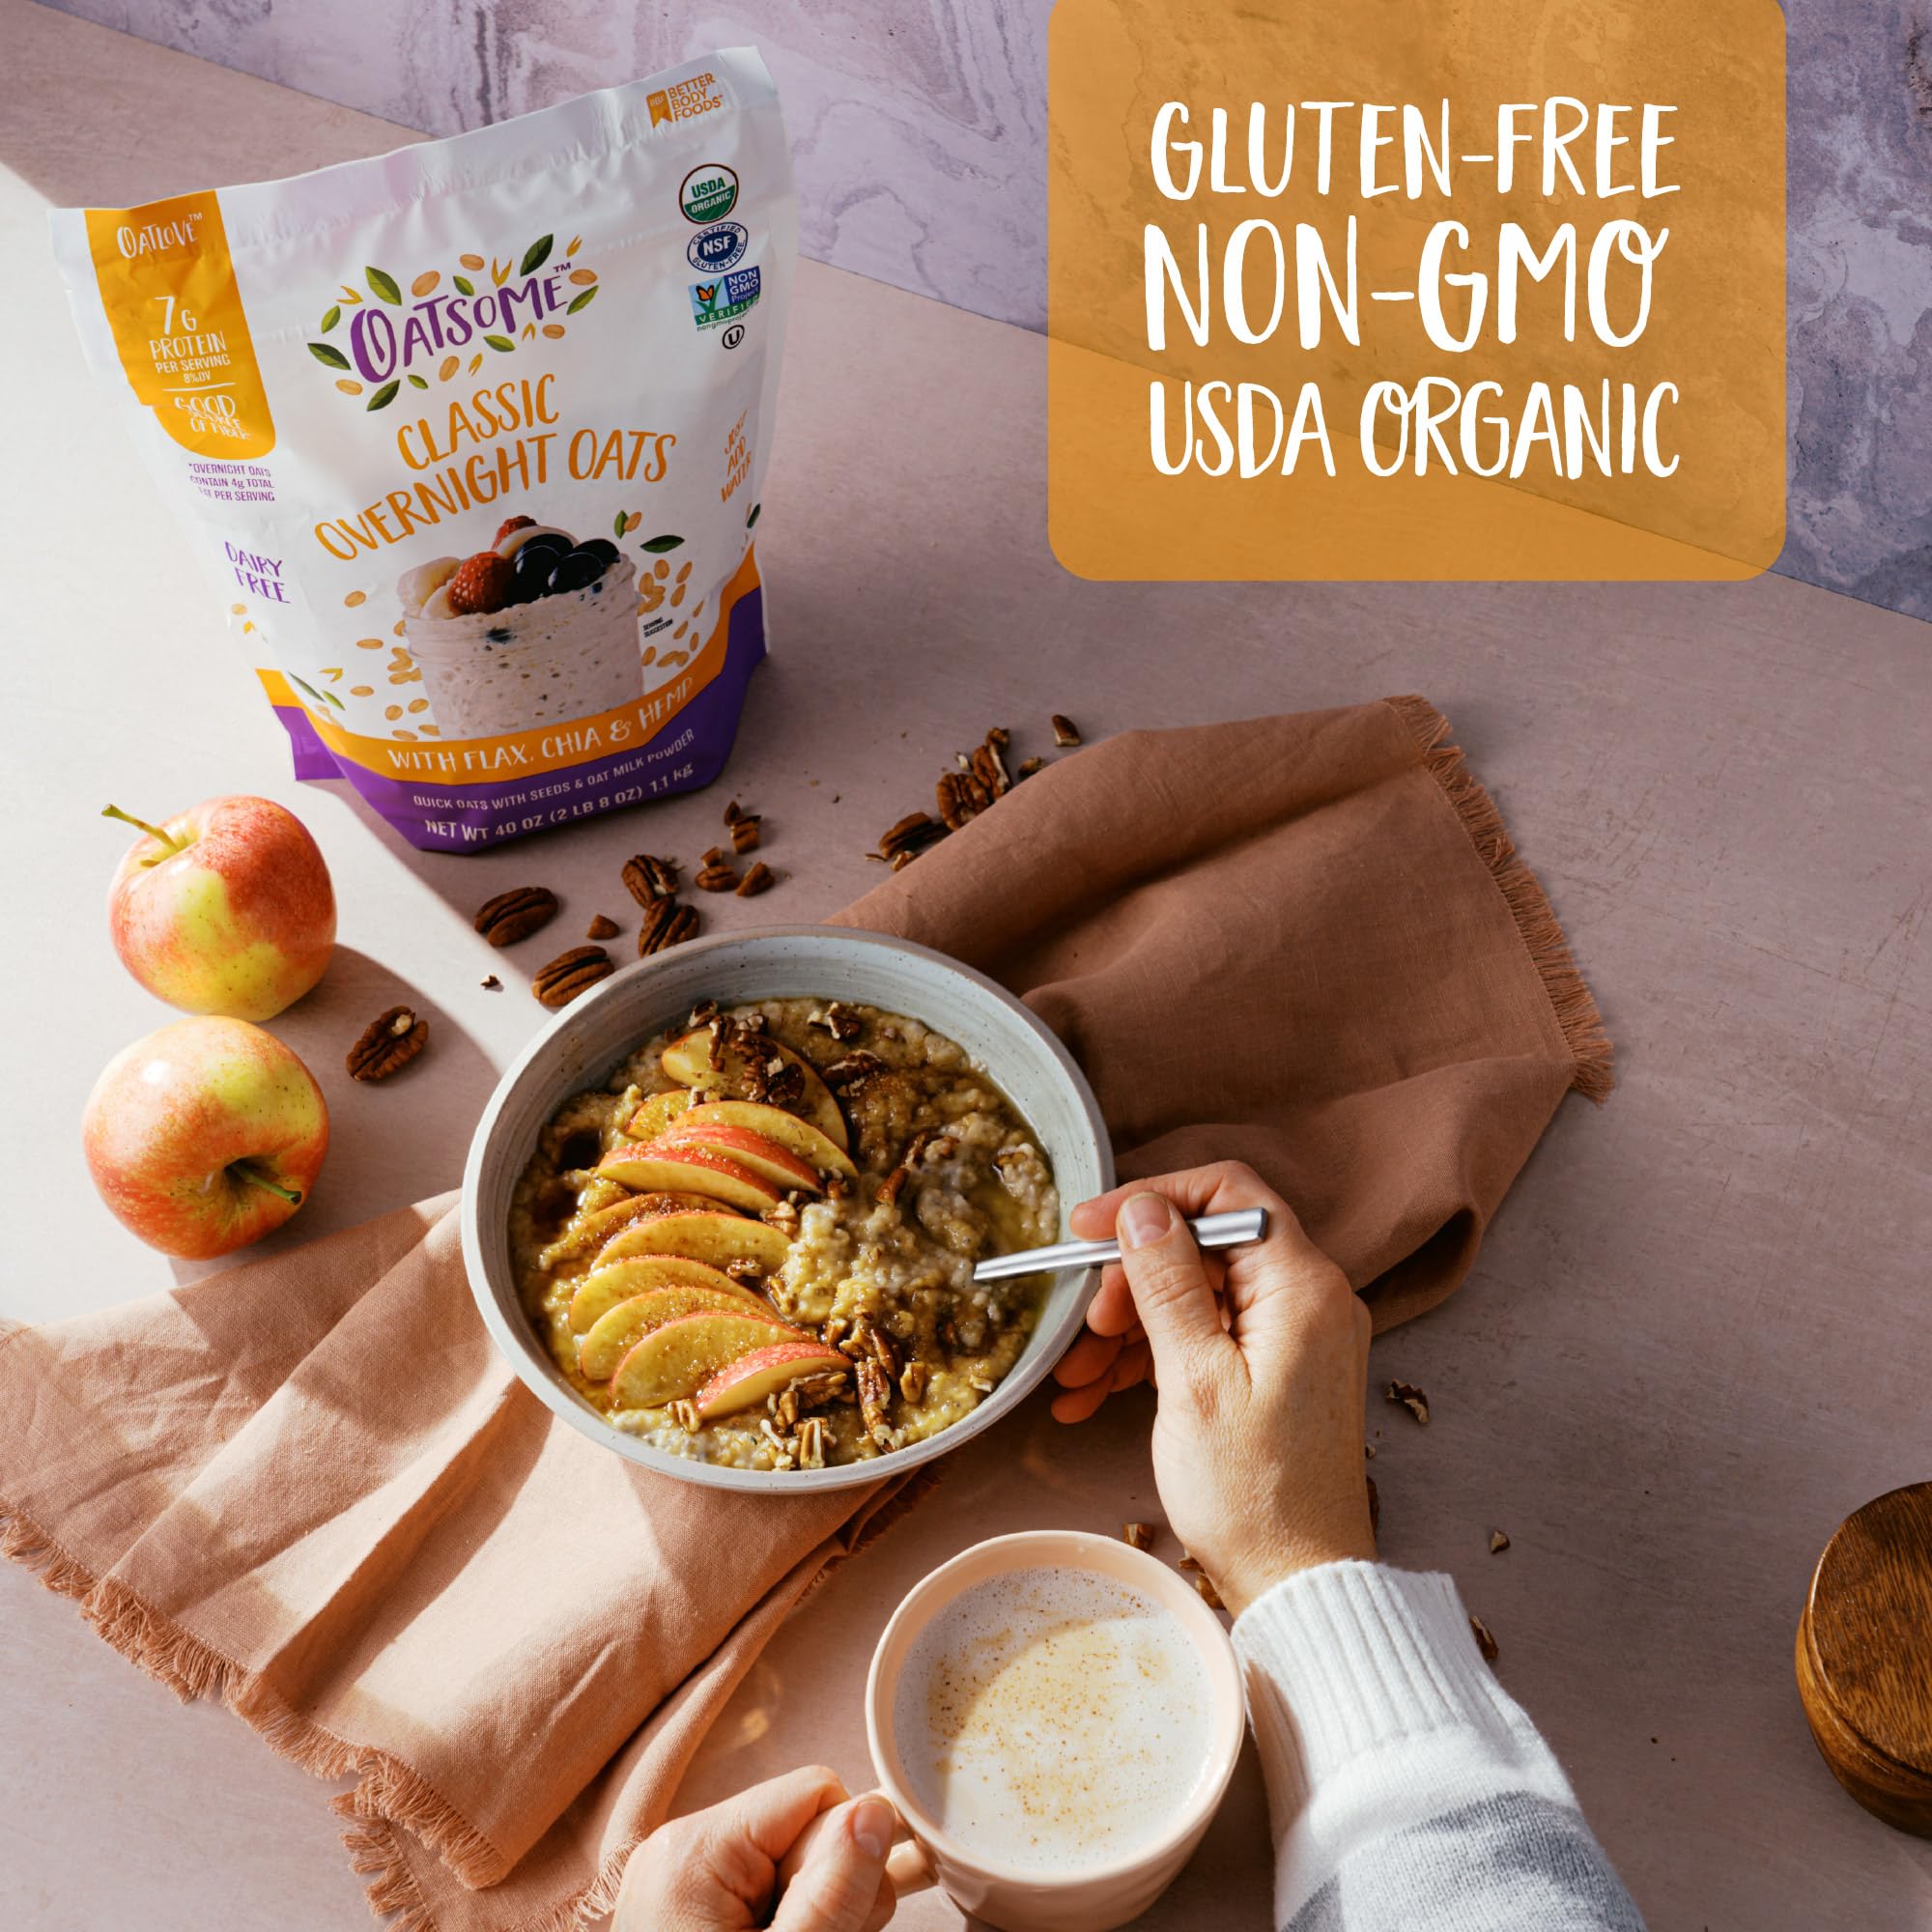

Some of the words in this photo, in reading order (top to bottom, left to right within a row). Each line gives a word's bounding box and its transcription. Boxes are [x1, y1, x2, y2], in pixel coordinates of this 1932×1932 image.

[668, 72, 716, 99] BETTER
[671, 88, 706, 110] BODY
[691, 177, 725, 199] USDA
[691, 191, 731, 213] ORGANIC
[693, 224, 742, 245] CERTIFIED
[702, 235, 732, 257] NSF
[727, 270, 757, 286] NON
[729, 278, 759, 296] GMO
[155, 295, 176, 335] 7
[181, 309, 197, 332] G
[149, 329, 227, 360] PROTEIN
[155, 361, 179, 375] PER
[180, 354, 231, 372] SERVING
[396, 373, 560, 470] CLASSIC
[231, 478, 244, 489] 4g
[245, 478, 275, 489] TOTAL
[247, 465, 271, 487] OATS
[214, 490, 233, 501] PER
[314, 432, 558, 561] OVERNIGHT
[568, 429, 677, 483] OATS
[224, 540, 283, 578] DAIRY
[234, 566, 292, 605] FREE
[387, 749, 457, 773] WITH
[541, 726, 603, 758] CHIA
[610, 719, 633, 743] &
[639, 676, 694, 731] HEMP
[412, 794, 454, 810] QUICK
[456, 799, 489, 810] OATS
[491, 792, 527, 810] WITH
[529, 781, 572, 802] SEEDS
[574, 779, 584, 790] &
[586, 770, 611, 786] OAT
[612, 756, 645, 778] MILK
[647, 727, 696, 763] POWDER
[424, 819, 458, 838] NET
[460, 823, 490, 842] WT
[495, 820, 518, 838] 40
[522, 813, 544, 831] OZ
[550, 808, 568, 823] (2
[572, 800, 594, 816] LB
[598, 795, 611, 810] 8
[613, 785, 644, 805] OZ)
[649, 775, 669, 794] 1.1
[672, 761, 695, 781] kg
